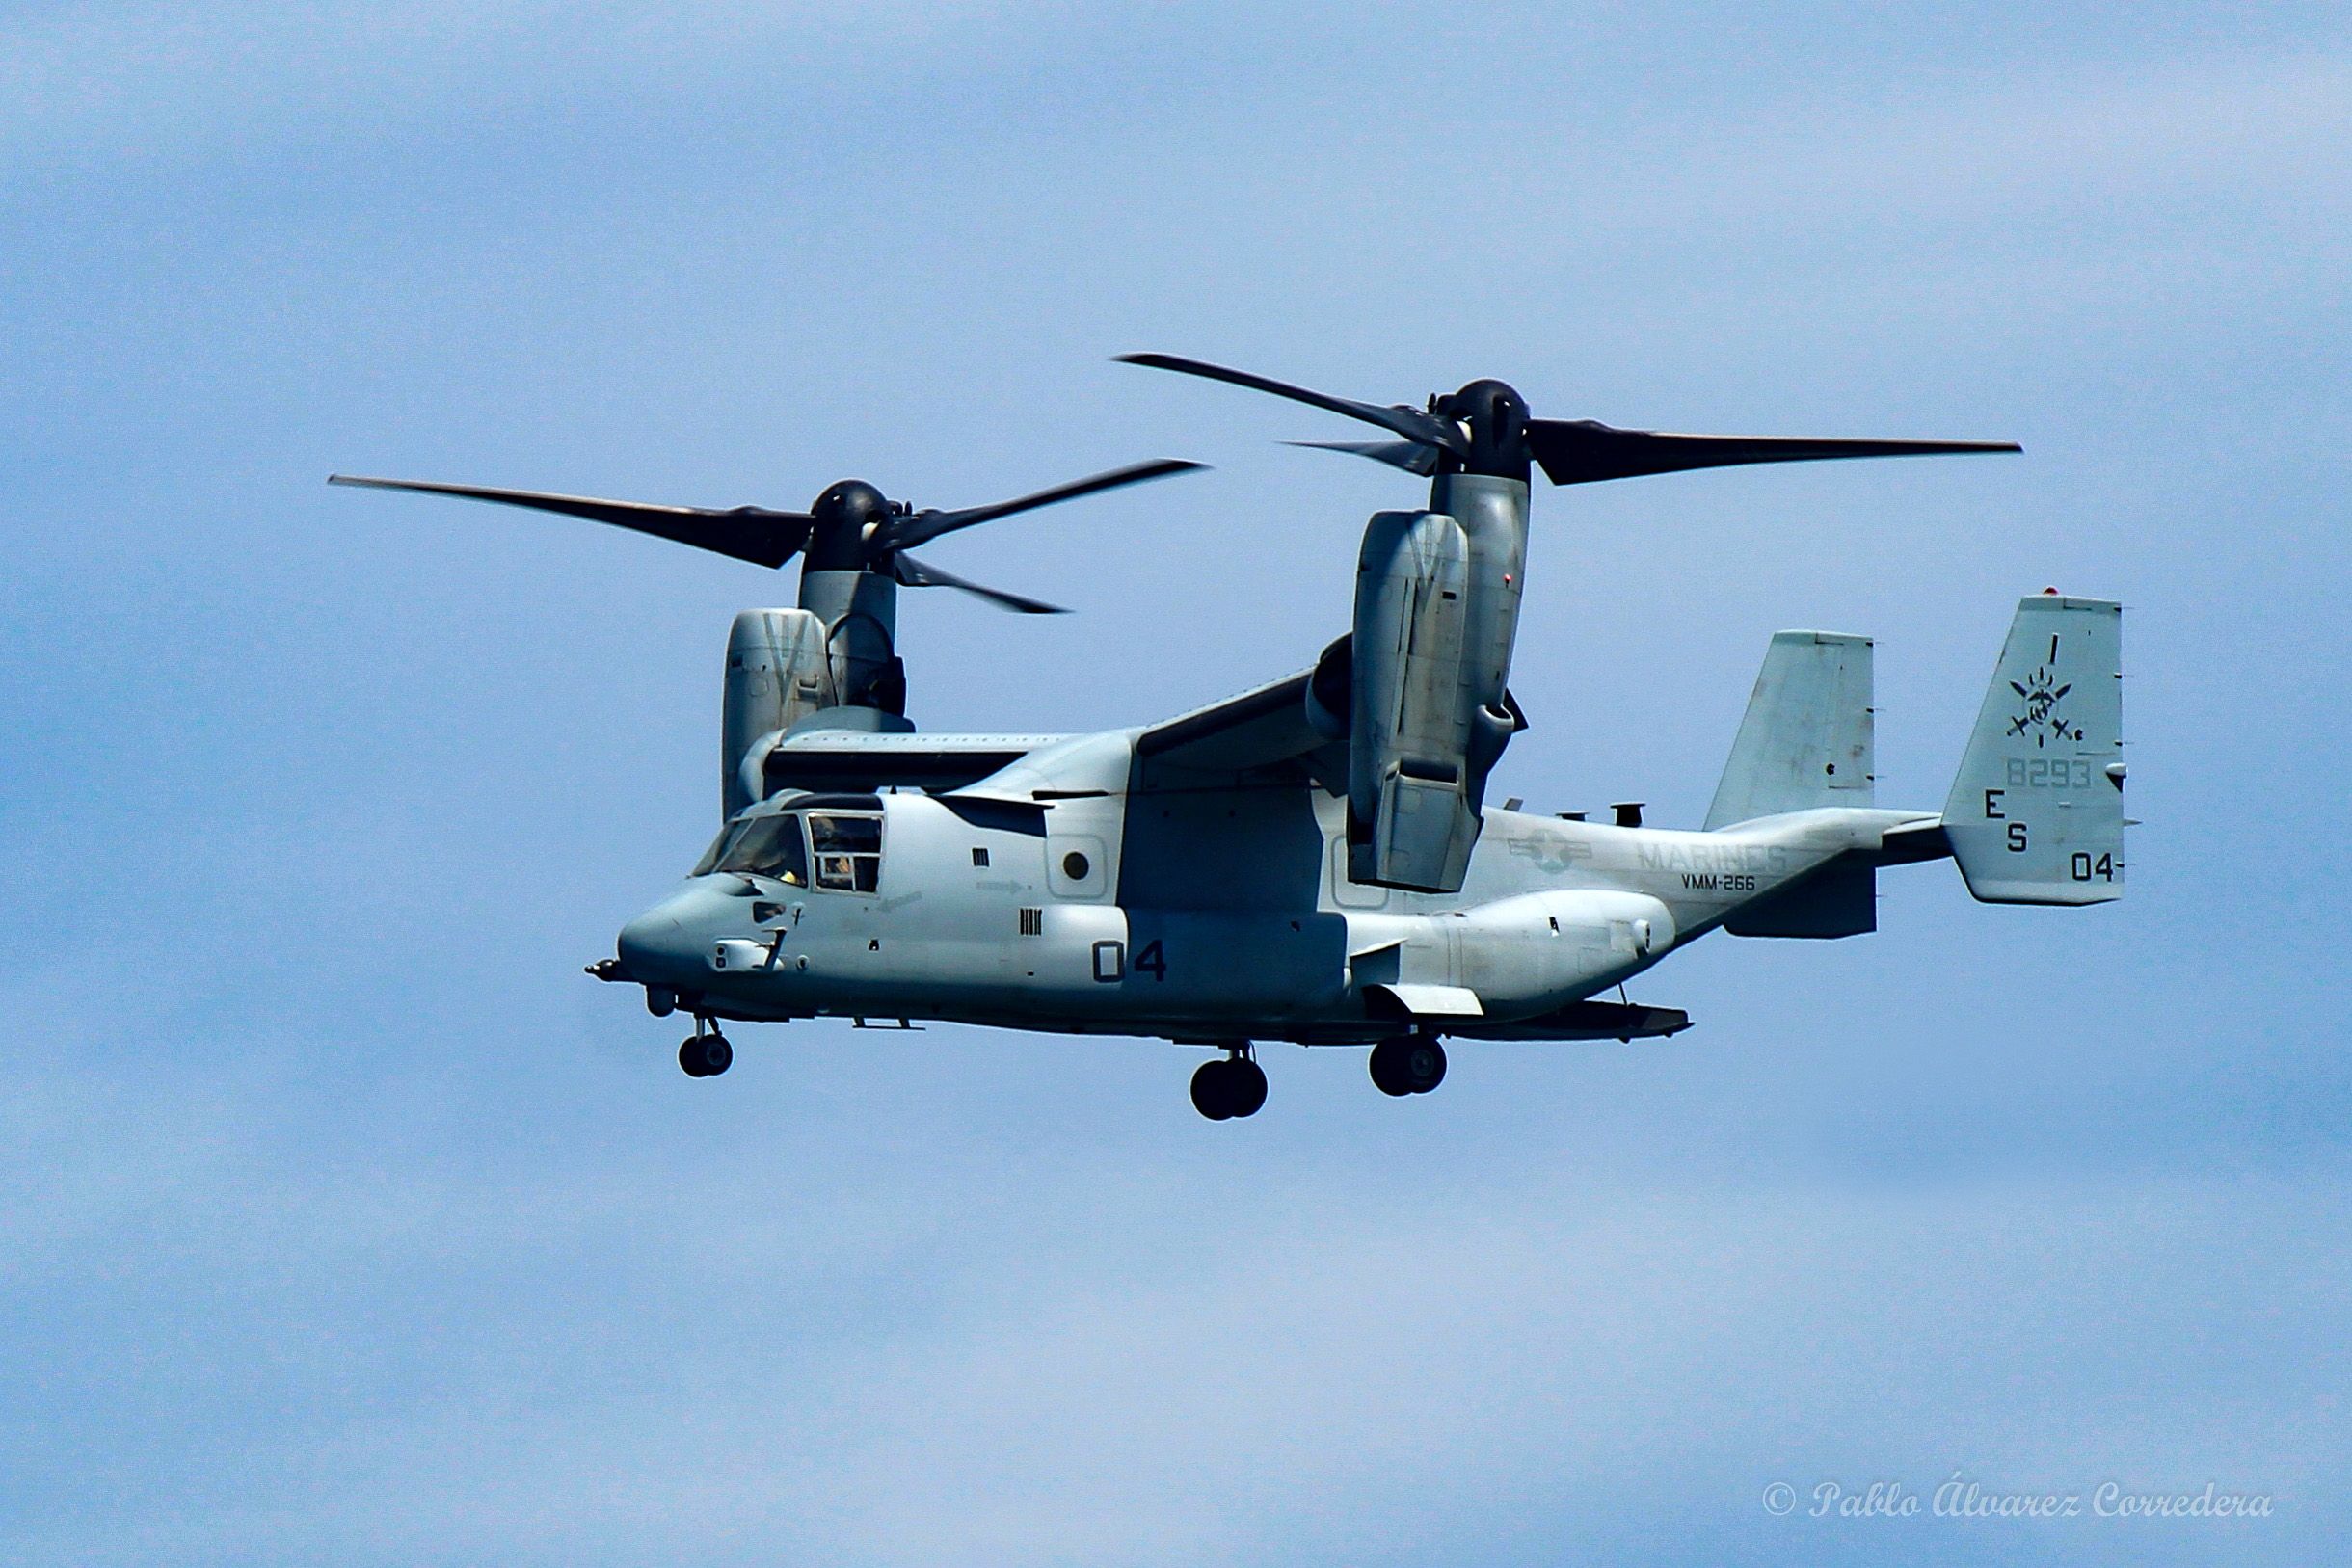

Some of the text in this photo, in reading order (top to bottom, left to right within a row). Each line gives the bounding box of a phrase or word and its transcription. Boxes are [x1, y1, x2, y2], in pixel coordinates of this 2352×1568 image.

[2007, 758, 2091, 787] 8293
[1986, 789, 2005, 819] E
[2007, 823, 2027, 852] S
[1637, 841, 1785, 871] MARINES
[2071, 853, 2113, 882] 04
[1681, 874, 1755, 890] VMM-266
[1092, 939, 1167, 983] 04
